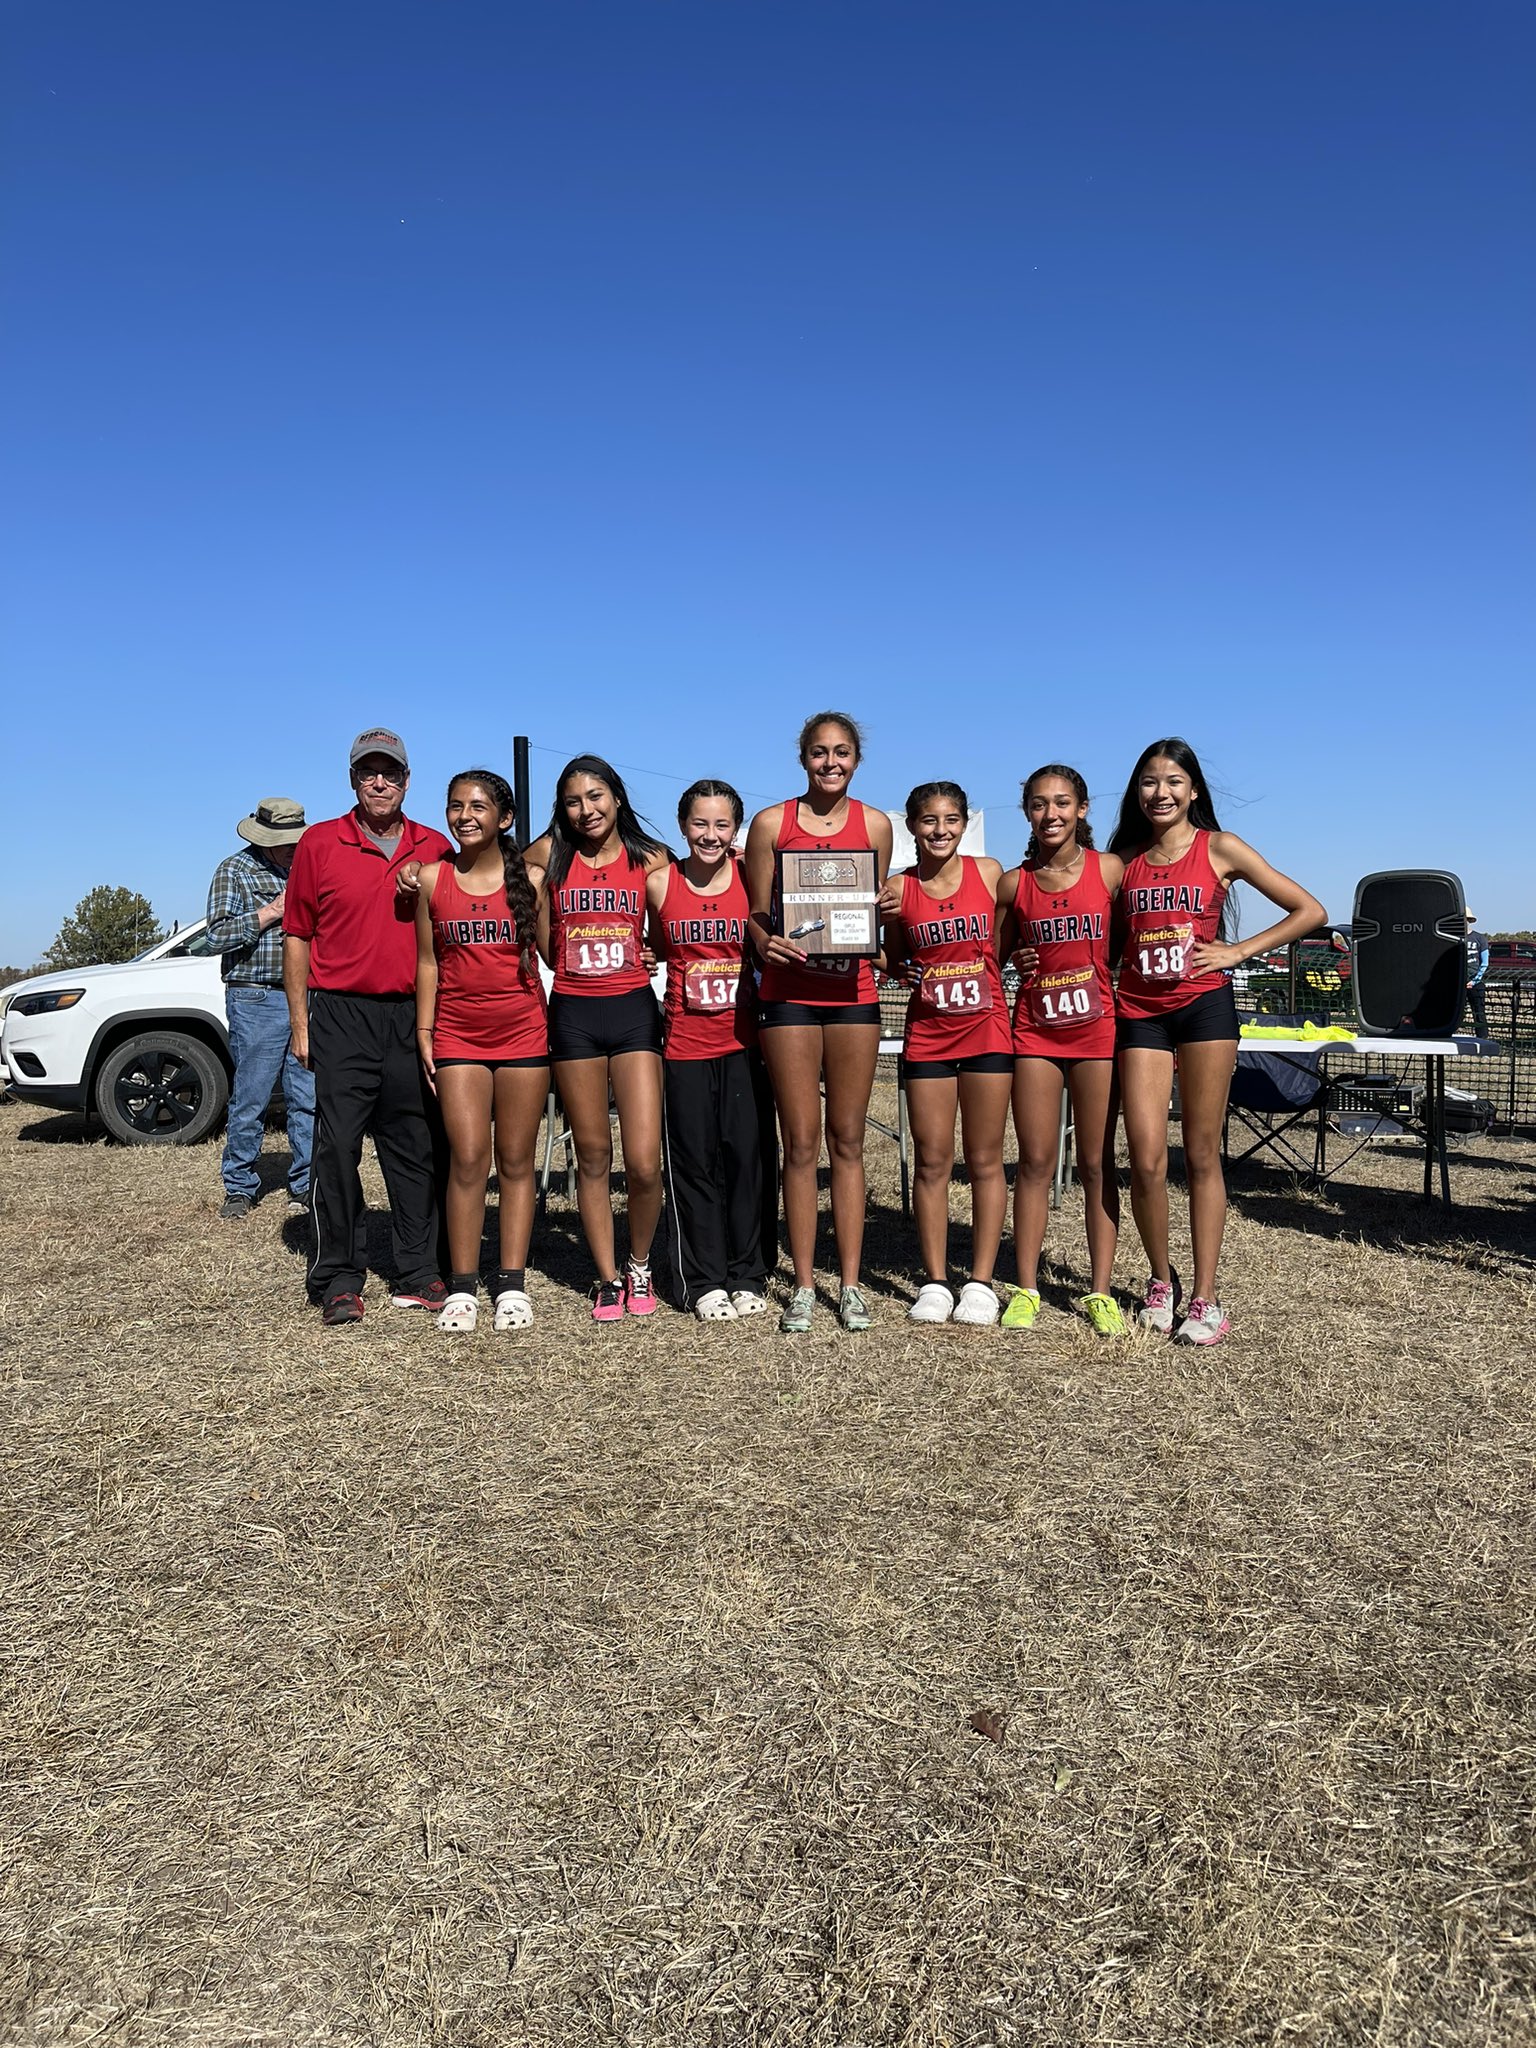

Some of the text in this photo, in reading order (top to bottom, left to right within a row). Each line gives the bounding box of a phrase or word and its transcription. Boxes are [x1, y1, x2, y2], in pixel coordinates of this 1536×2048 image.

[559, 888, 639, 915] LIBERAL
[789, 893, 868, 902] RUNNER-UP
[834, 913, 865, 921] REGIONAL
[1023, 913, 1103, 947] LIBERAL
[1392, 923, 1424, 933] EON
[908, 913, 990, 950] LIBERAL
[579, 942, 624, 969] 139
[1139, 945, 1184, 975] 138
[699, 978, 740, 1004] 137
[934, 979, 981, 1009] 143
[1042, 988, 1090, 1019] 140
